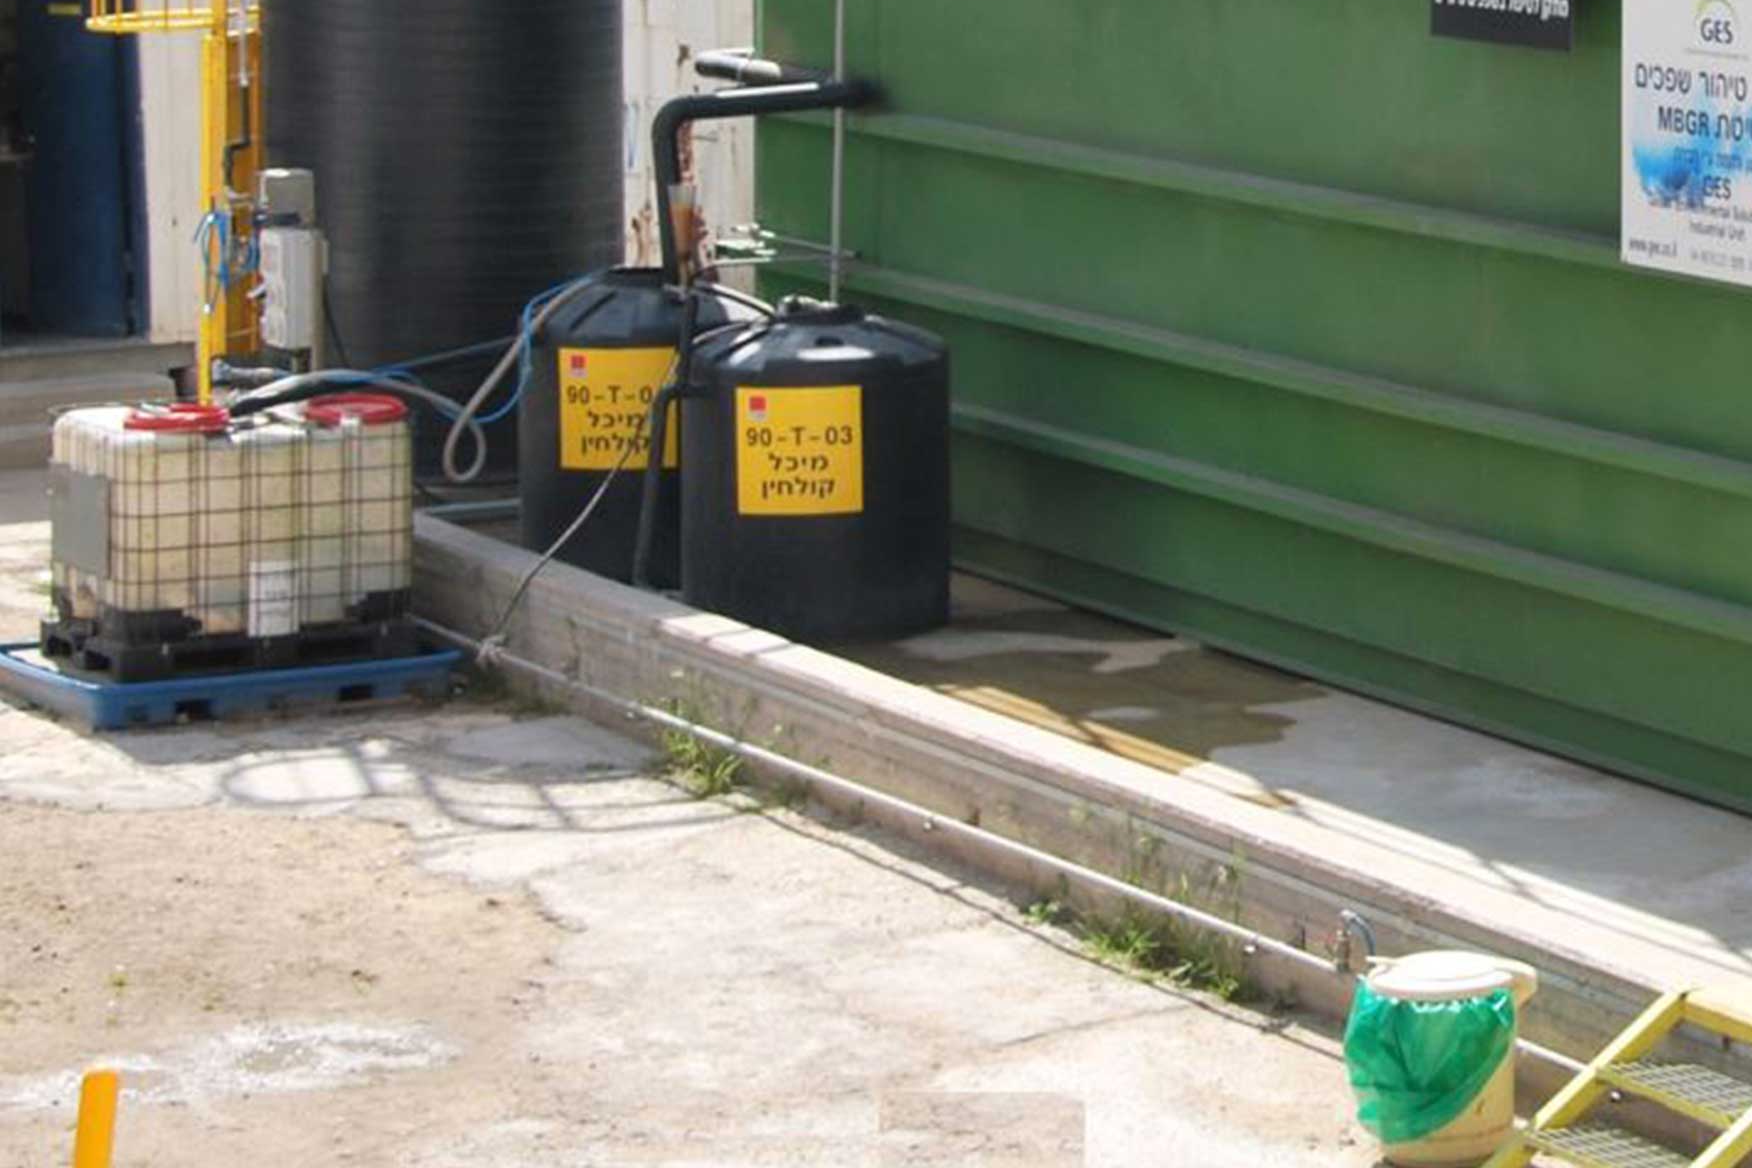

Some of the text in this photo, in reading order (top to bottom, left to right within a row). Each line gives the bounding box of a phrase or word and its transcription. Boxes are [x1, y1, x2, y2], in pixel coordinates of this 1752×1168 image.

[1700, 18, 1734, 44] GES
[1635, 63, 1692, 94] שפכים
[1699, 72, 1748, 101] טיהור
[566, 385, 653, 405] 90-T-0
[768, 453, 829, 471] מיכל
[762, 477, 835, 500] קולחין
